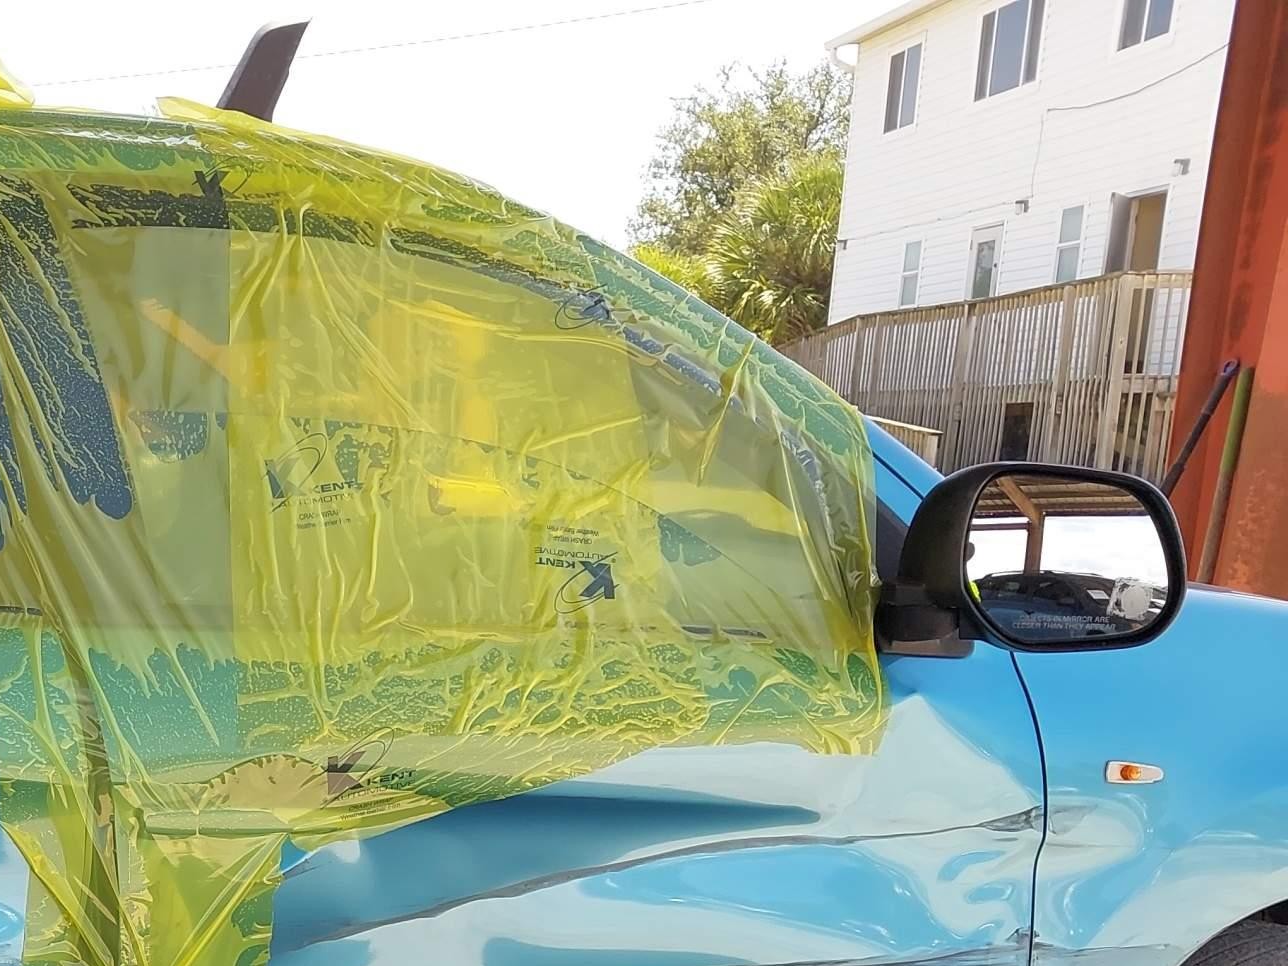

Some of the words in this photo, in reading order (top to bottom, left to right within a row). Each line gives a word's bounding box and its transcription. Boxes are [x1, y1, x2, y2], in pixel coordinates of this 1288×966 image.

[534, 546, 608, 561] AUTOMOTIVE
[535, 557, 576, 569] KENT
[1063, 615, 1092, 623] MIRROR
[1094, 616, 1111, 624] ARE
[1042, 622, 1063, 630] THAN
[1064, 622, 1084, 630] THEY
[367, 769, 417, 786] KENT
